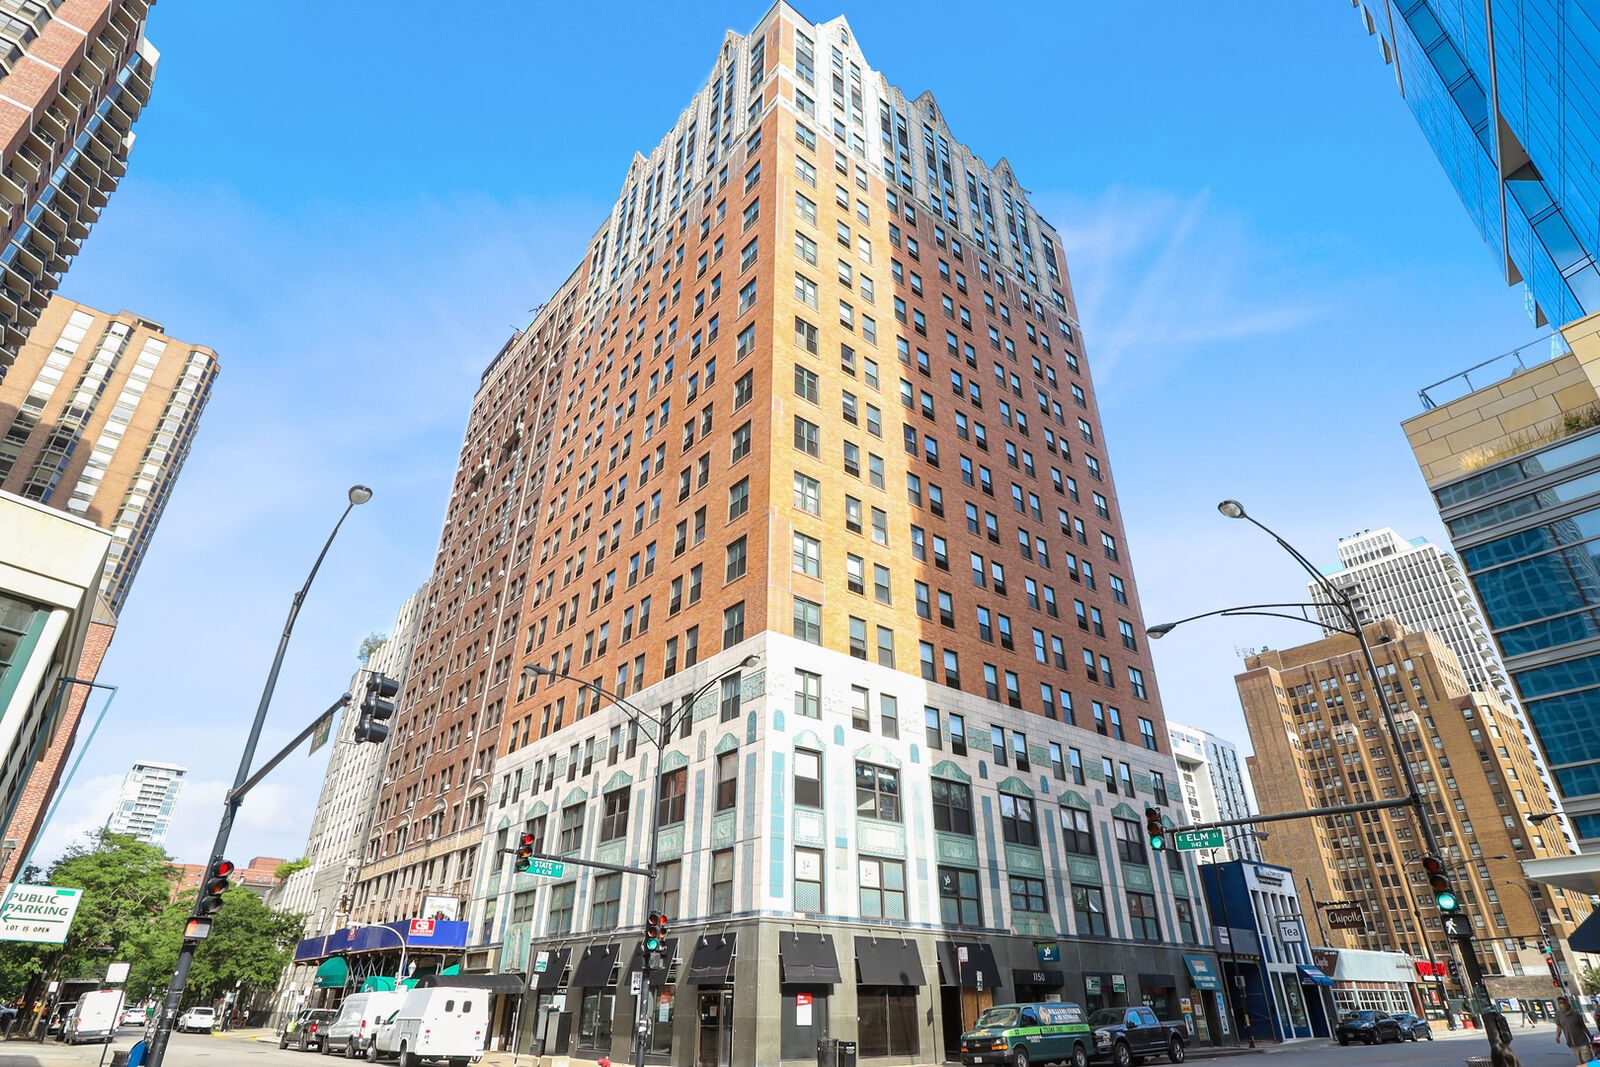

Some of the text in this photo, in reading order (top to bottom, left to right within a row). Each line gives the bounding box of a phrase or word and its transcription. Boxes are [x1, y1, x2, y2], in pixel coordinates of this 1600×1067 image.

[1186, 832, 1209, 841] ELM
[534, 861, 552, 870] STATE
[11, 892, 59, 904] PUBLIC
[4, 904, 69, 916] PARKING
[1329, 912, 1362, 926] Chipotle
[1282, 927, 1298, 936] Tea
[1033, 973, 1045, 981] 1150
